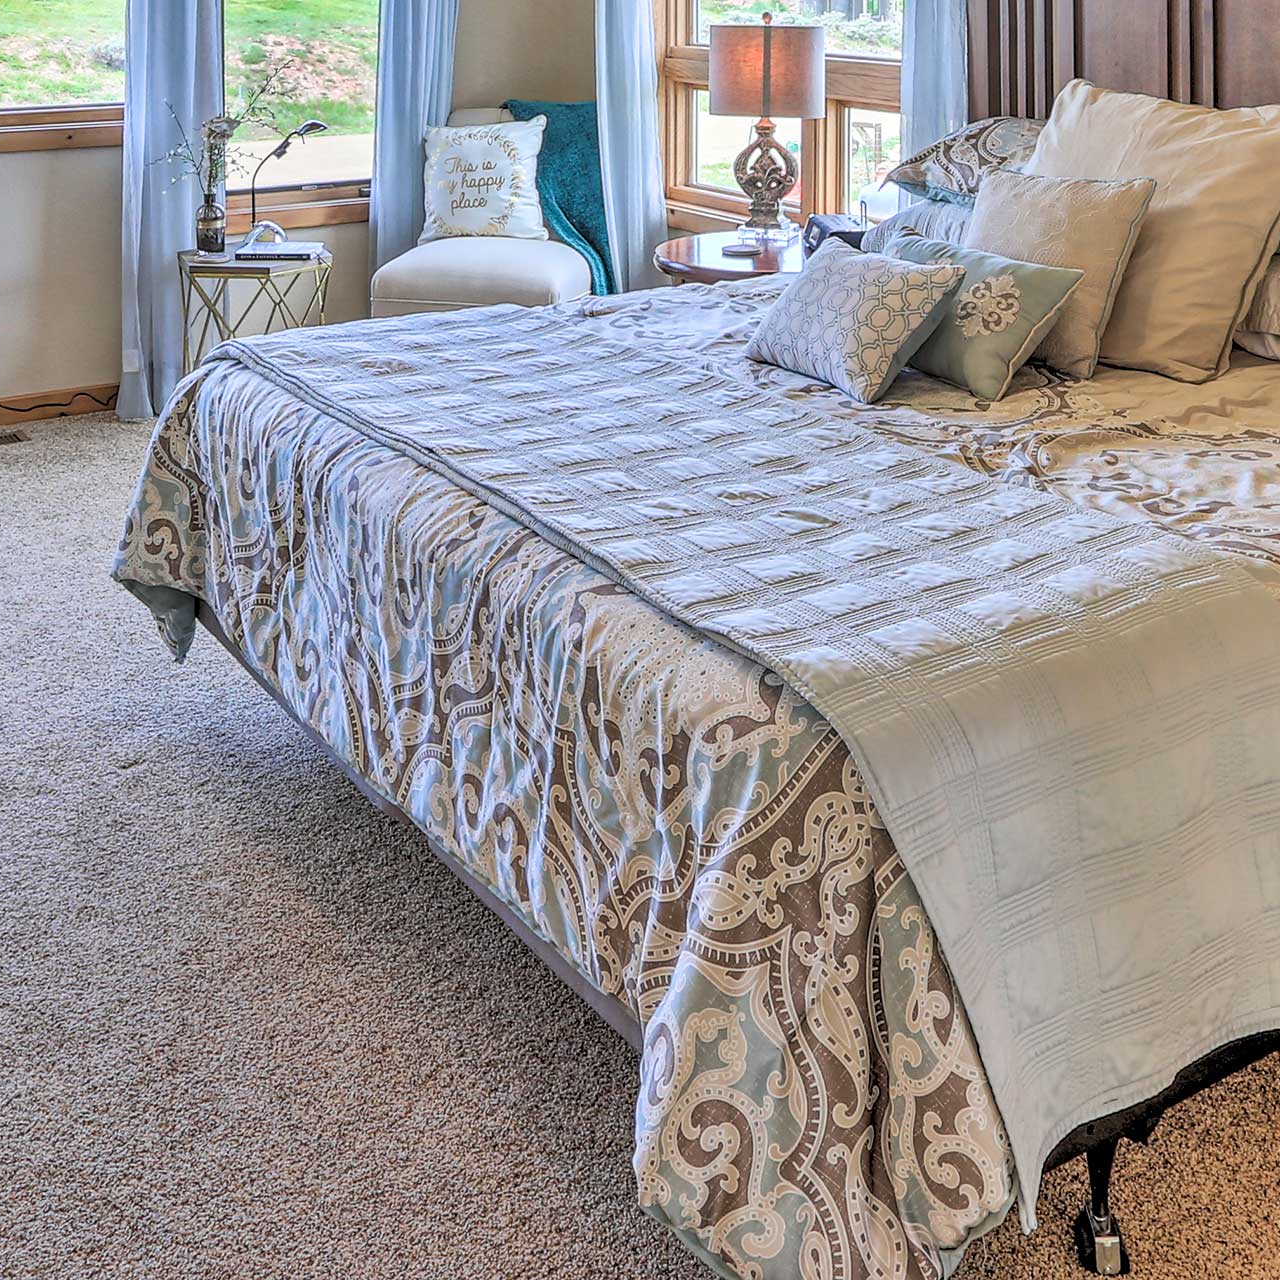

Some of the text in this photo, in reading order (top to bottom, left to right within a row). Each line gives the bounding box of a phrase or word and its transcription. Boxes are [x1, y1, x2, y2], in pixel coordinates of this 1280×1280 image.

[444, 156, 497, 174] This is
[461, 173, 505, 194] happy
[451, 192, 488, 216] place
